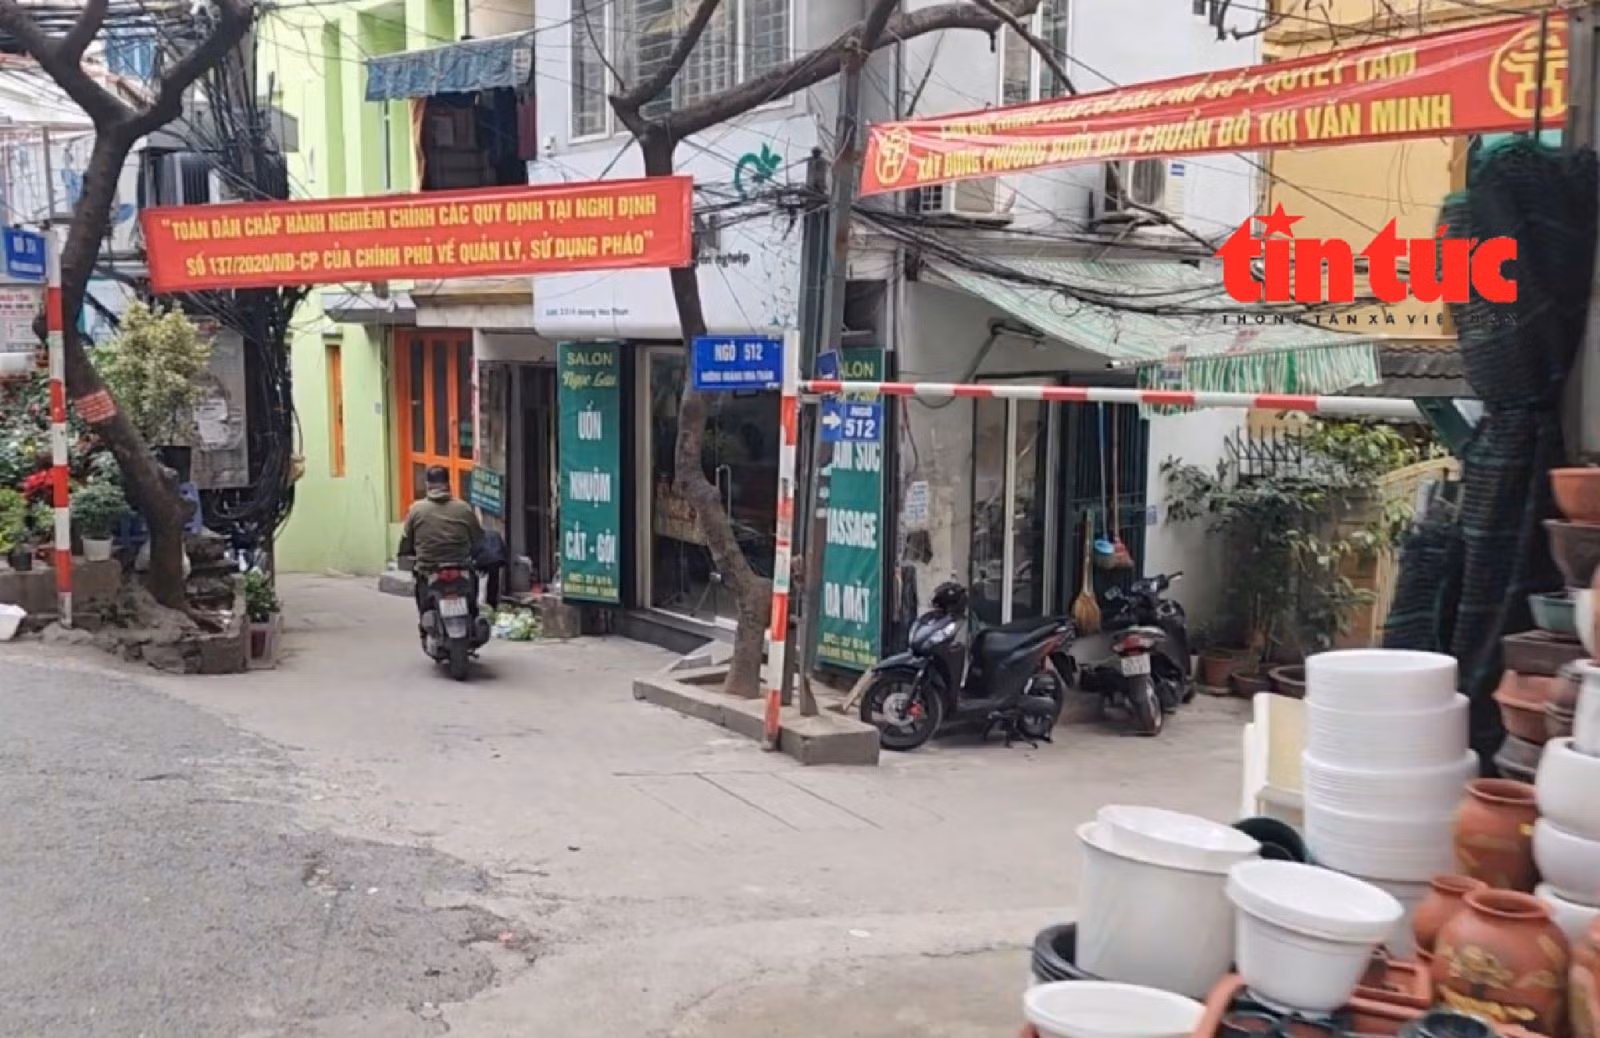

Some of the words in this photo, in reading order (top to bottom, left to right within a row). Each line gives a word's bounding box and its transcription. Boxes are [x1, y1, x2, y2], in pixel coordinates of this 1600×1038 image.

[1355, 48, 1418, 83] TÂM
[1137, 108, 1211, 153] CHUẨN
[1259, 109, 1298, 147] THỊ
[1304, 96, 1361, 138] VĂN
[1371, 94, 1452, 134] MINH
[212, 215, 241, 239] DÂN
[244, 208, 281, 236] CHẤP
[286, 210, 326, 233] HÀNH
[328, 205, 386, 231] NGHIÊM
[438, 202, 469, 225] CÁC
[472, 203, 501, 226] QUY
[506, 201, 543, 226] ĐỊNH
[547, 199, 572, 224] TẠI
[575, 197, 614, 221] NGHỊ
[617, 194, 657, 221] ĐỊNH
[185, 251, 206, 277] SỐ
[323, 242, 352, 269] CỦA
[355, 244, 400, 267] CHÍNH
[403, 236, 433, 264] PHỦ
[459, 232, 500, 264] QUẢN
[529, 231, 553, 259] SỬ
[554, 235, 598, 262] DỤNG
[567, 352, 613, 367] SALON
[714, 340, 736, 362] NGÕ
[743, 342, 763, 362] 512
[578, 400, 603, 440] UỐN
[845, 418, 876, 438] 512
[569, 466, 611, 508] NHUỘN
